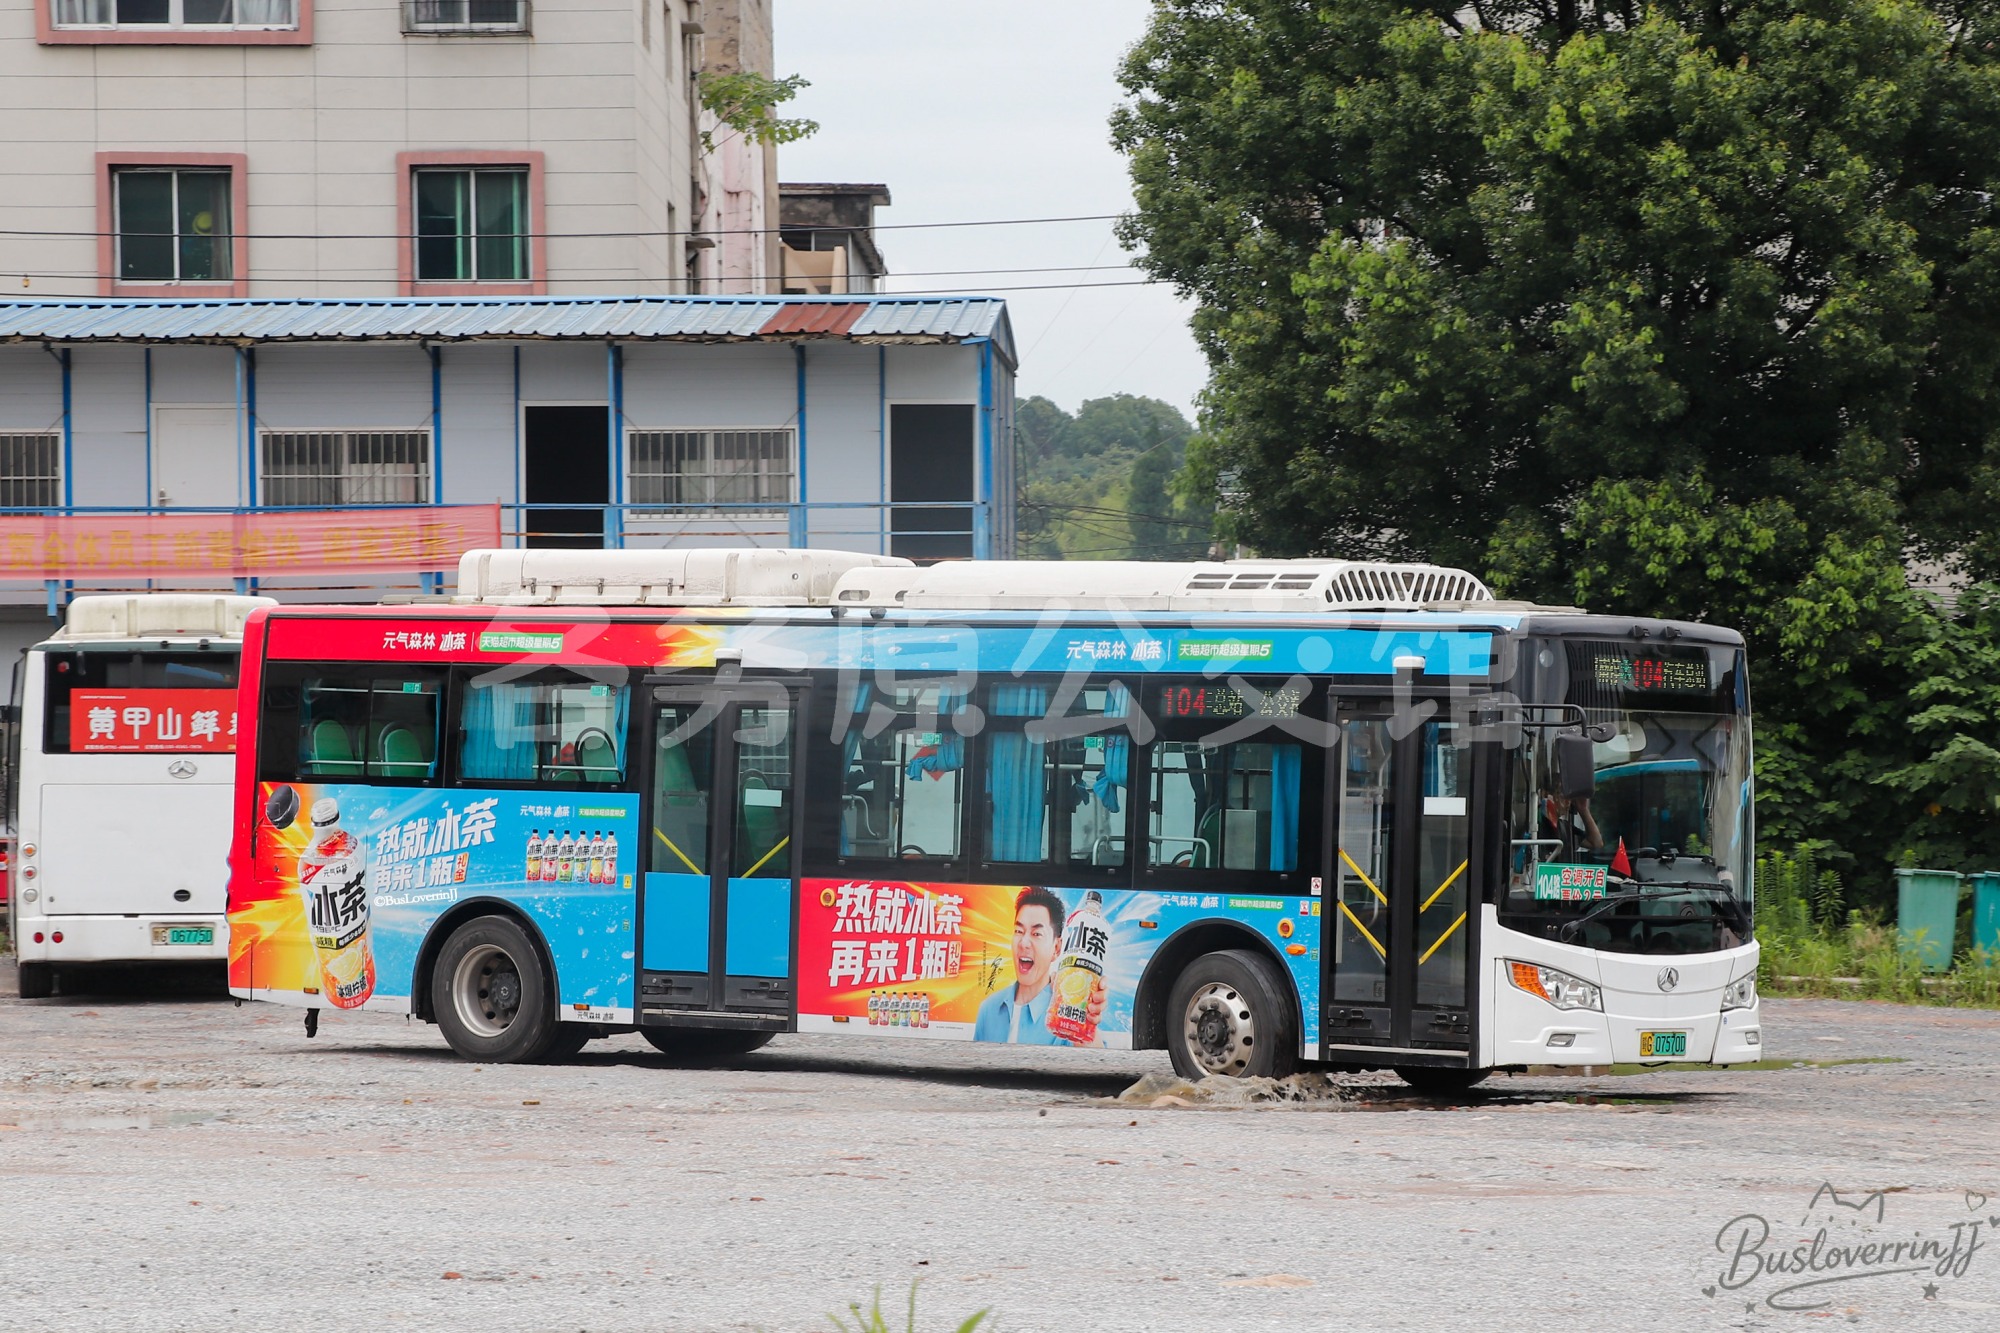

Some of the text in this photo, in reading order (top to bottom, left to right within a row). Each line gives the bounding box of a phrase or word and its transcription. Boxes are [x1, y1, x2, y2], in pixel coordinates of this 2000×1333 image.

[382, 630, 562, 651] 元气森林 冰茶 天猫超市超级星期5
[1066, 638, 1271, 661] 元气森林 冰茶 天猫超市超级星期5
[1163, 687, 1206, 716] 104
[375, 796, 499, 868] 热就冰茶
[374, 853, 455, 895] 再来1瓶
[1561, 867, 1605, 888] 空调开启
[311, 869, 367, 928] 冰茶
[831, 880, 964, 936] 热就冰茶
[1063, 920, 1109, 961] 冰茶
[827, 937, 949, 988] 再来1瓶
